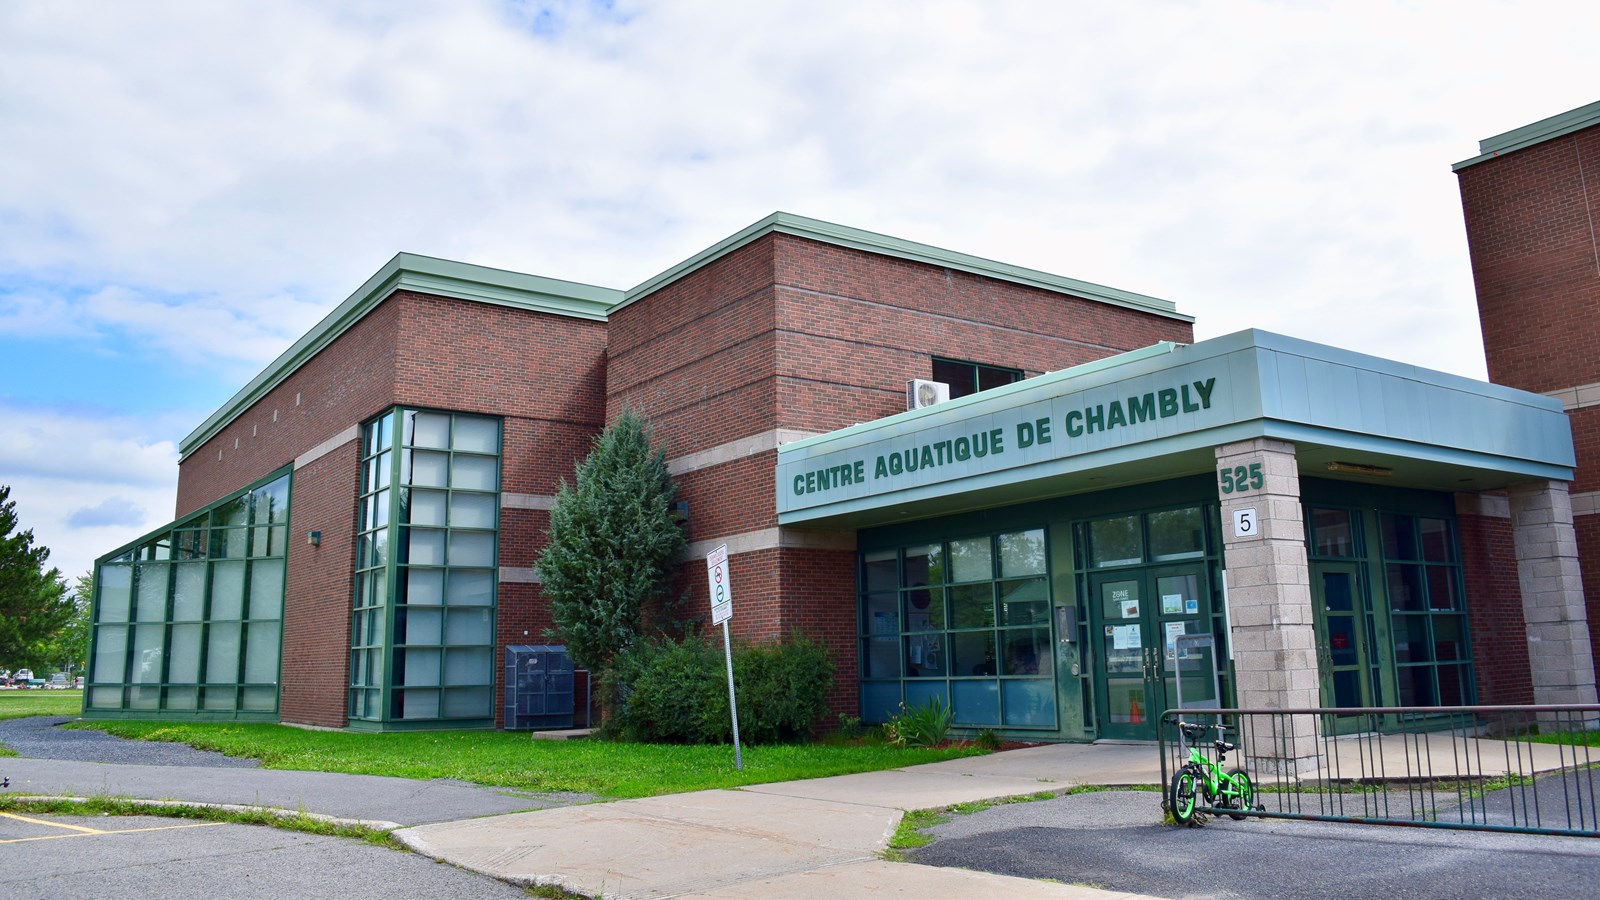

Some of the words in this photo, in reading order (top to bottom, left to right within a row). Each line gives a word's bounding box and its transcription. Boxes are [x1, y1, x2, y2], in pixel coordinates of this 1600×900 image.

[793, 460, 865, 496] CENTRE
[874, 428, 1004, 479] AQUATIQUE
[1016, 417, 1052, 449] DE
[1065, 377, 1216, 438] CHAMBLY
[1220, 463, 1264, 494] 525
[1240, 513, 1251, 532] 5
[1112, 590, 1128, 598] ZONE
